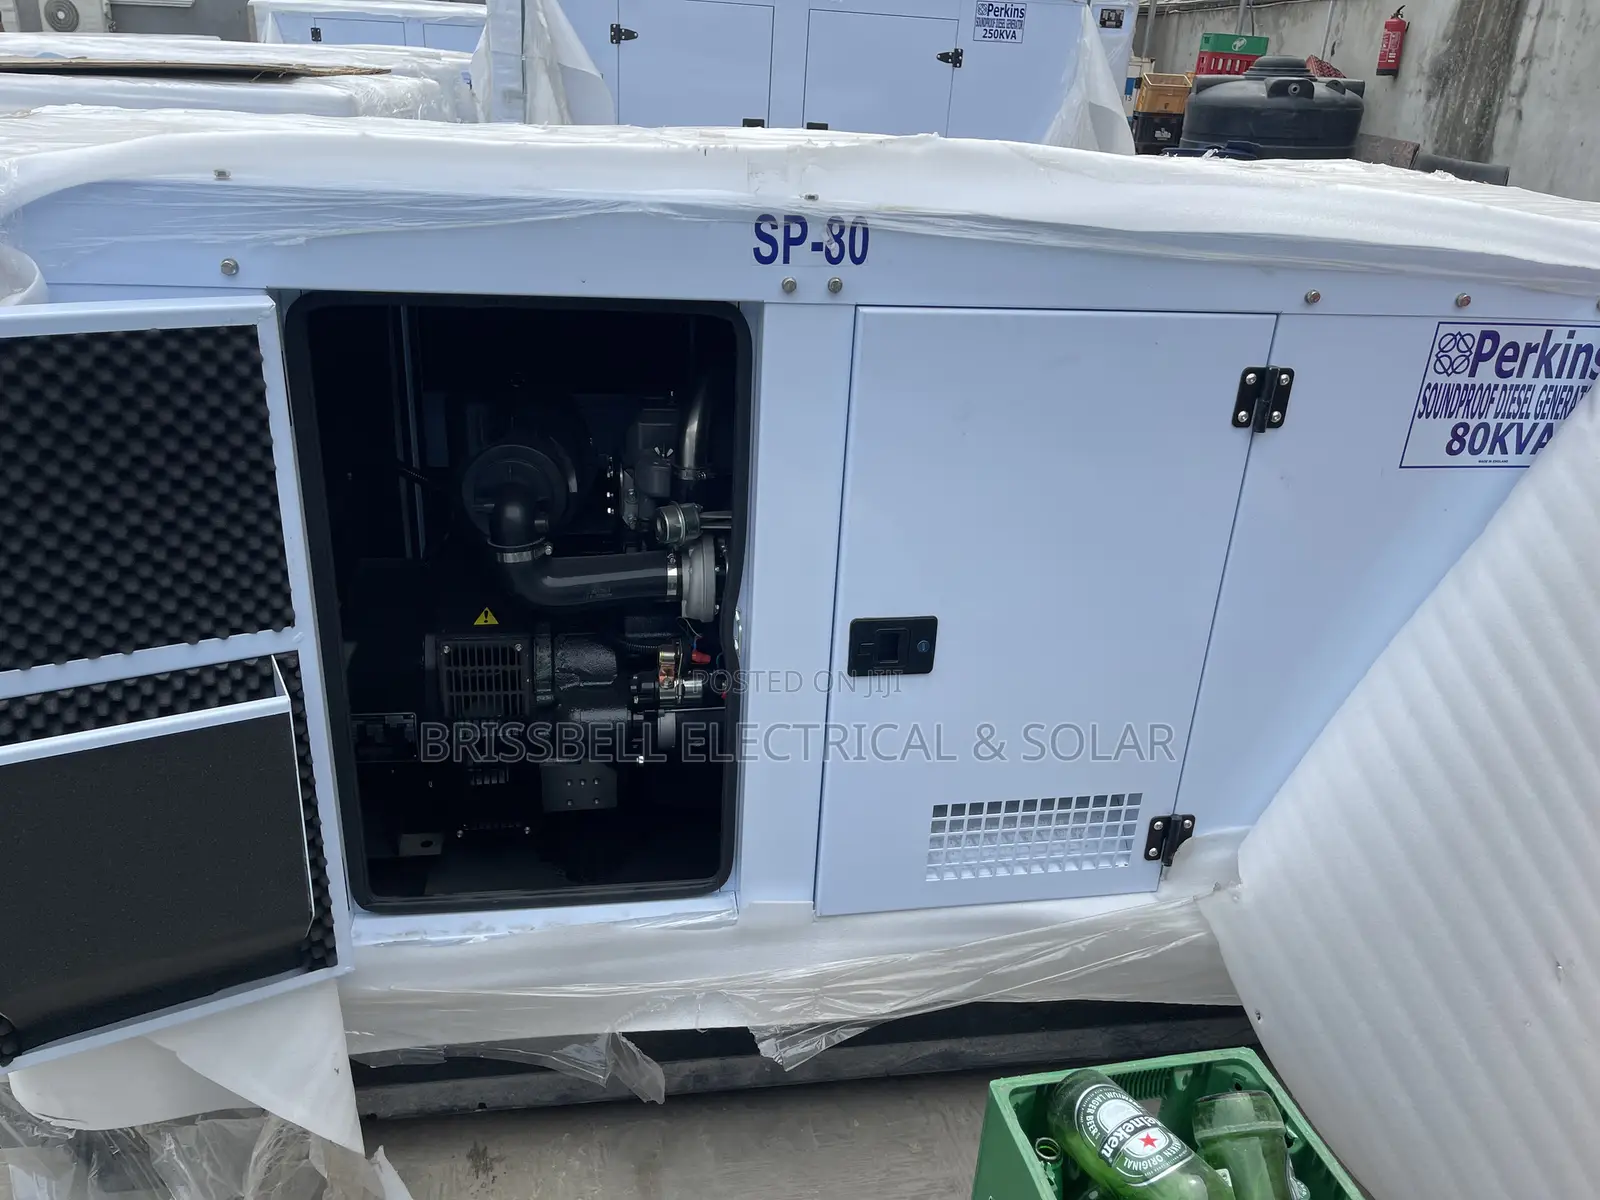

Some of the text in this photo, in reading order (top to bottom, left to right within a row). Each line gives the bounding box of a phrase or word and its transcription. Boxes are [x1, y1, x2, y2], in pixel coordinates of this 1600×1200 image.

[986, 3, 1025, 19] Perkins
[982, 28, 1017, 40] 250KVA
[753, 214, 869, 265] SP-80
[1417, 382, 1592, 420] SOUNDPROOF DIESEL GENERAT
[1445, 421, 1555, 456] 80KVA
[1085, 1093, 1107, 1114] LAGER
[1085, 1115, 1099, 1137] BEER
[1101, 1116, 1157, 1158] eineken
[1119, 1153, 1164, 1171] ORIGINAL
